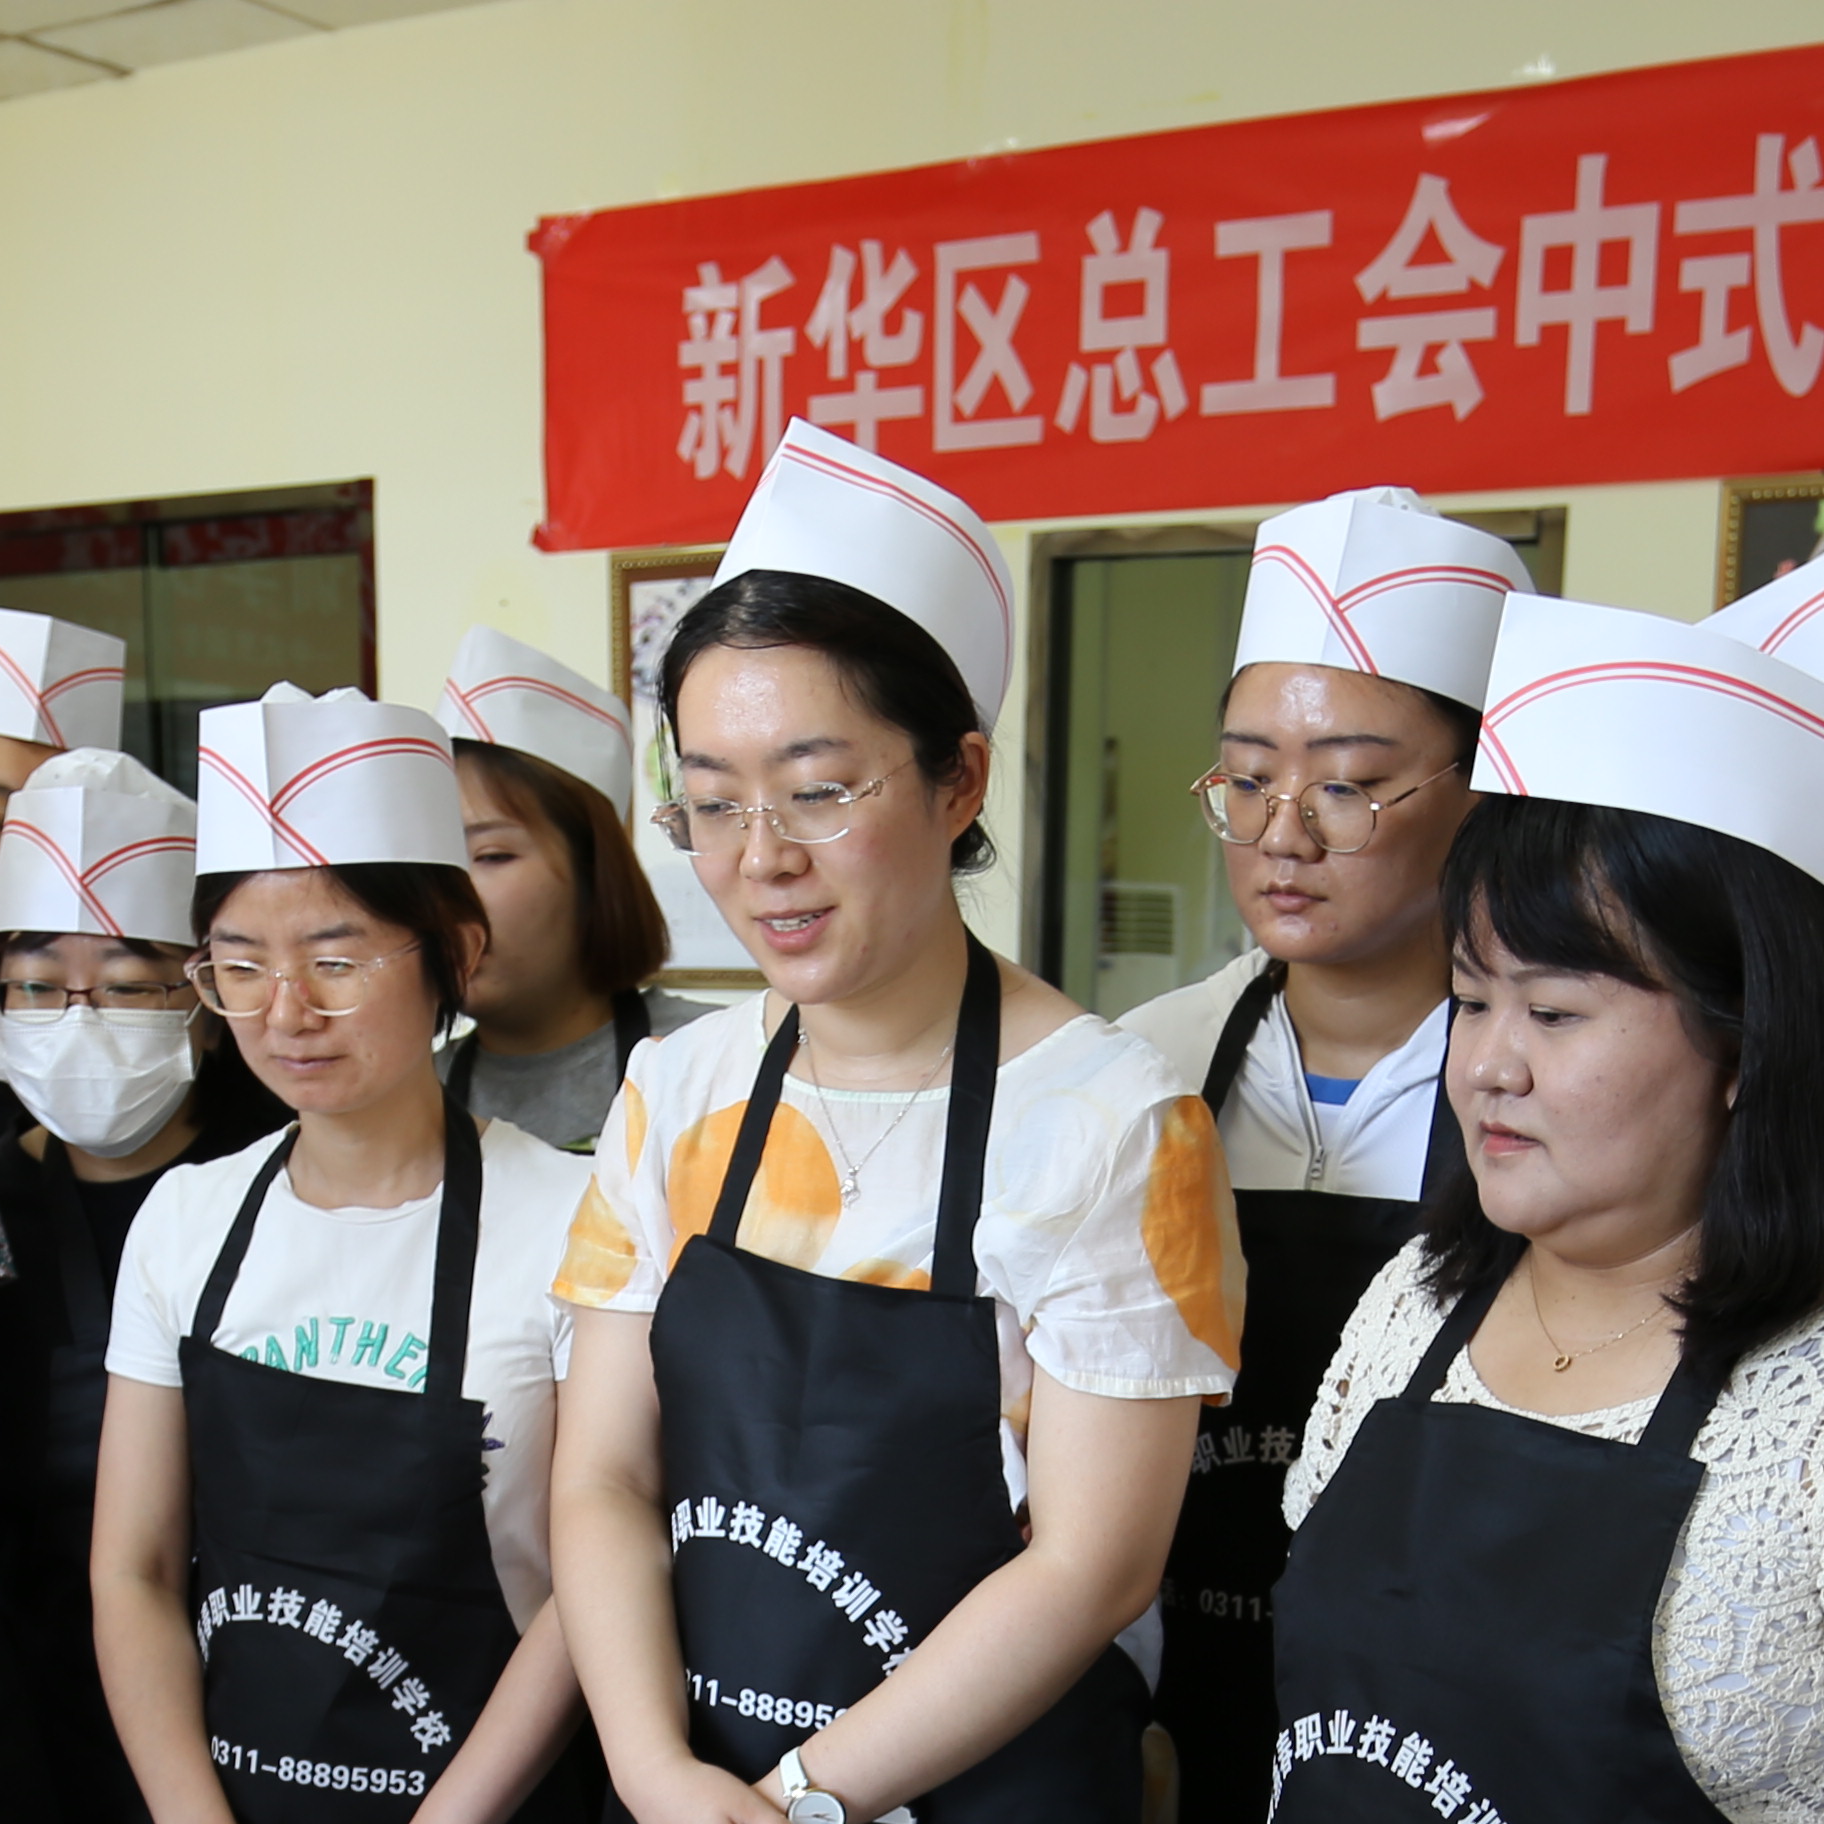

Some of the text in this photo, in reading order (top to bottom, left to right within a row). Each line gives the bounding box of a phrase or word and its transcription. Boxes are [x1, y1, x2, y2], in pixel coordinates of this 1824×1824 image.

[671, 1496, 914, 1677] 职业技能培训学
[210, 1735, 426, 1796] 0311-88895953
